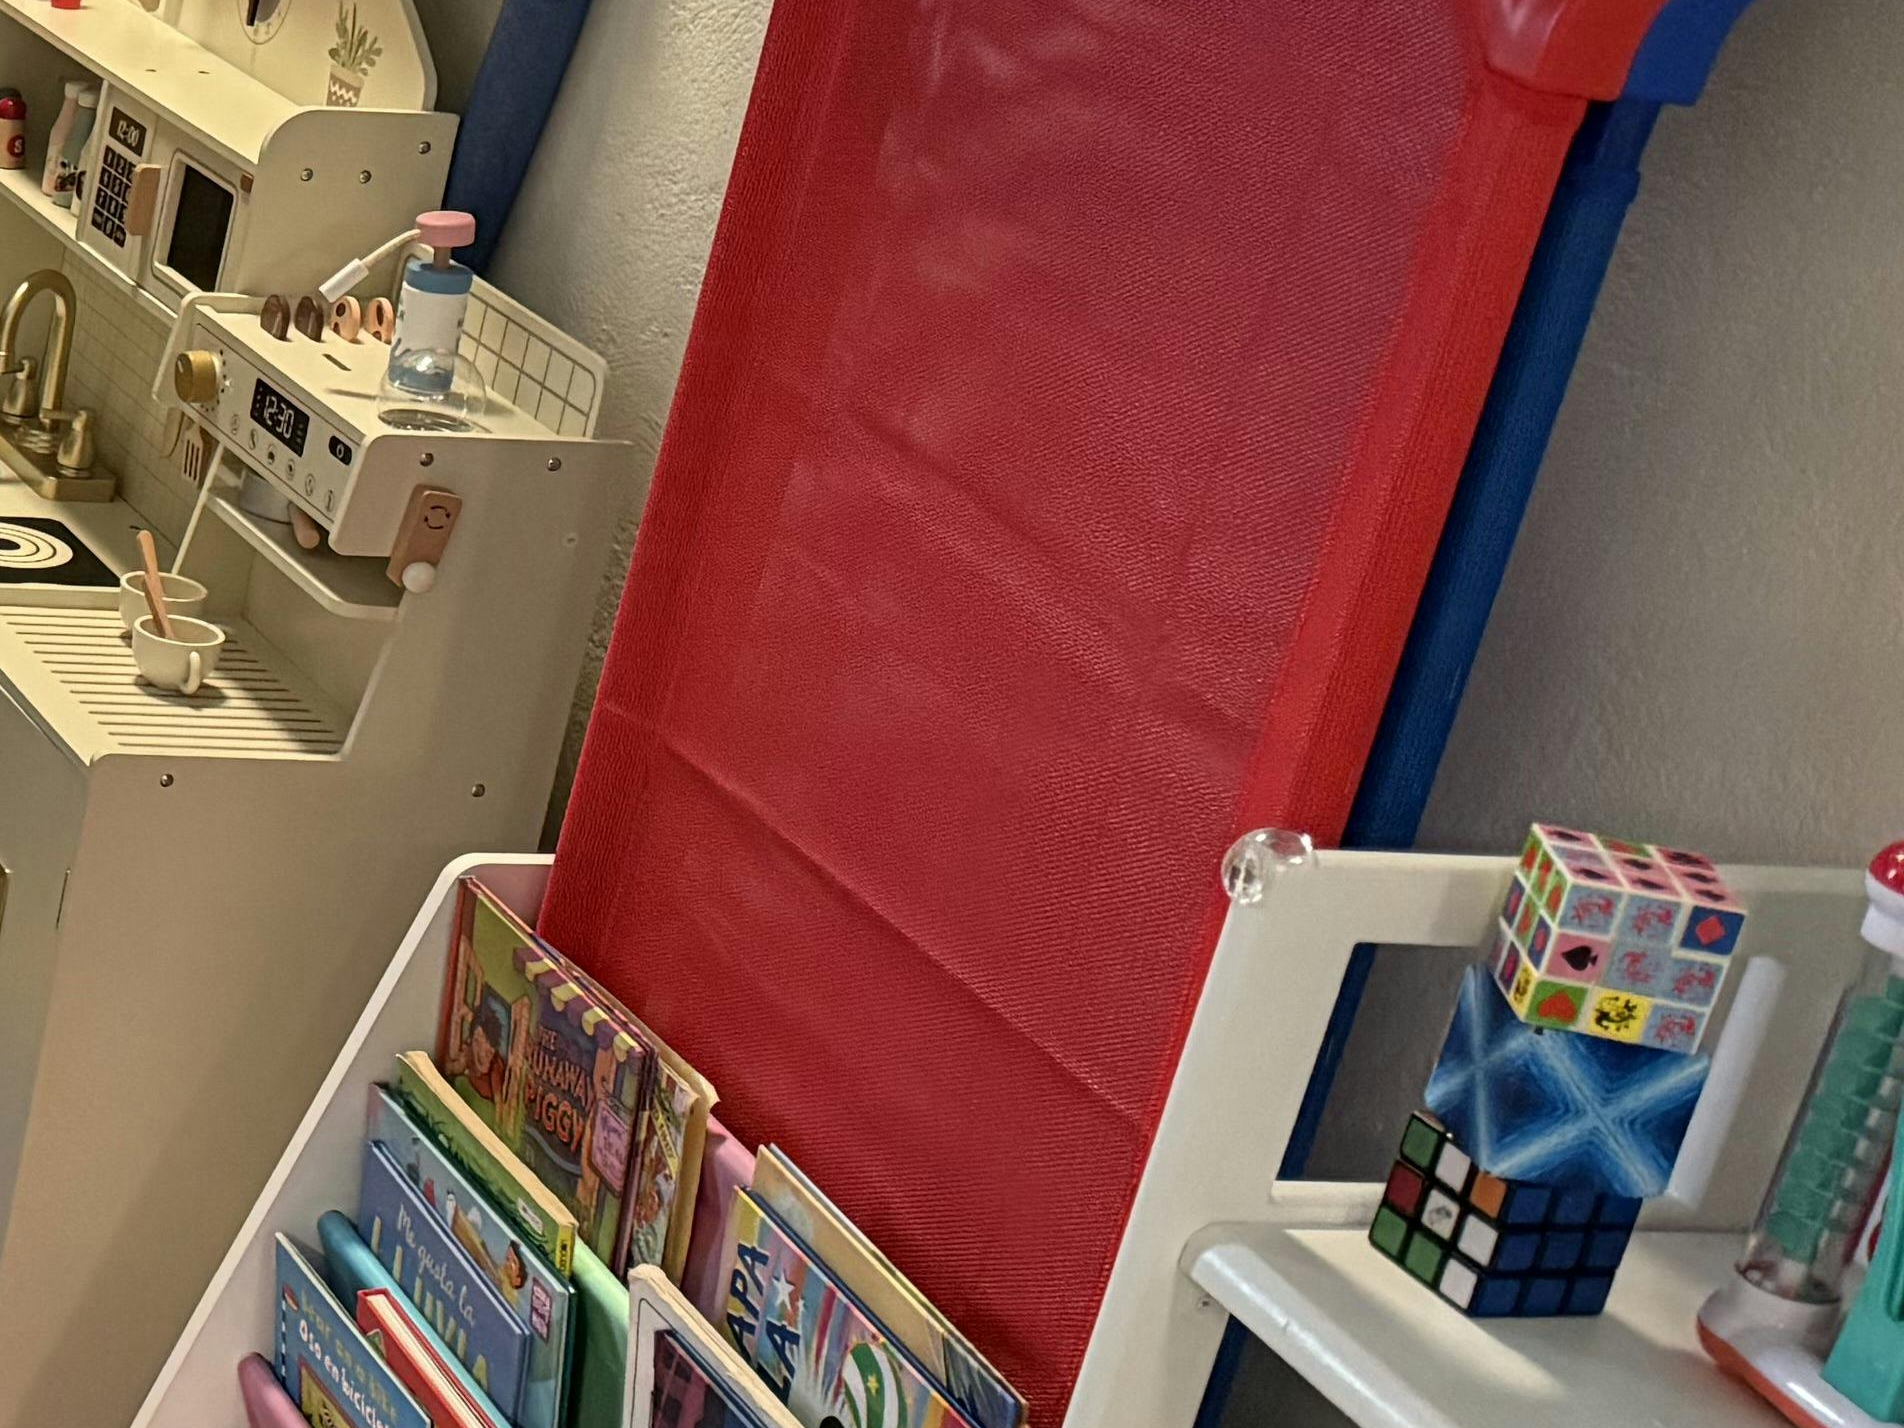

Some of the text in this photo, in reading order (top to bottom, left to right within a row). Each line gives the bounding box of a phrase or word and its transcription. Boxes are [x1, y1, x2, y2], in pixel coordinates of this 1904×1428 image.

[262, 394, 295, 439] 12:30
[525, 1075, 585, 1154] PIGGY
[458, 1284, 476, 1328] la
[298, 1318, 322, 1361] Oso
[324, 1354, 340, 1383] en
